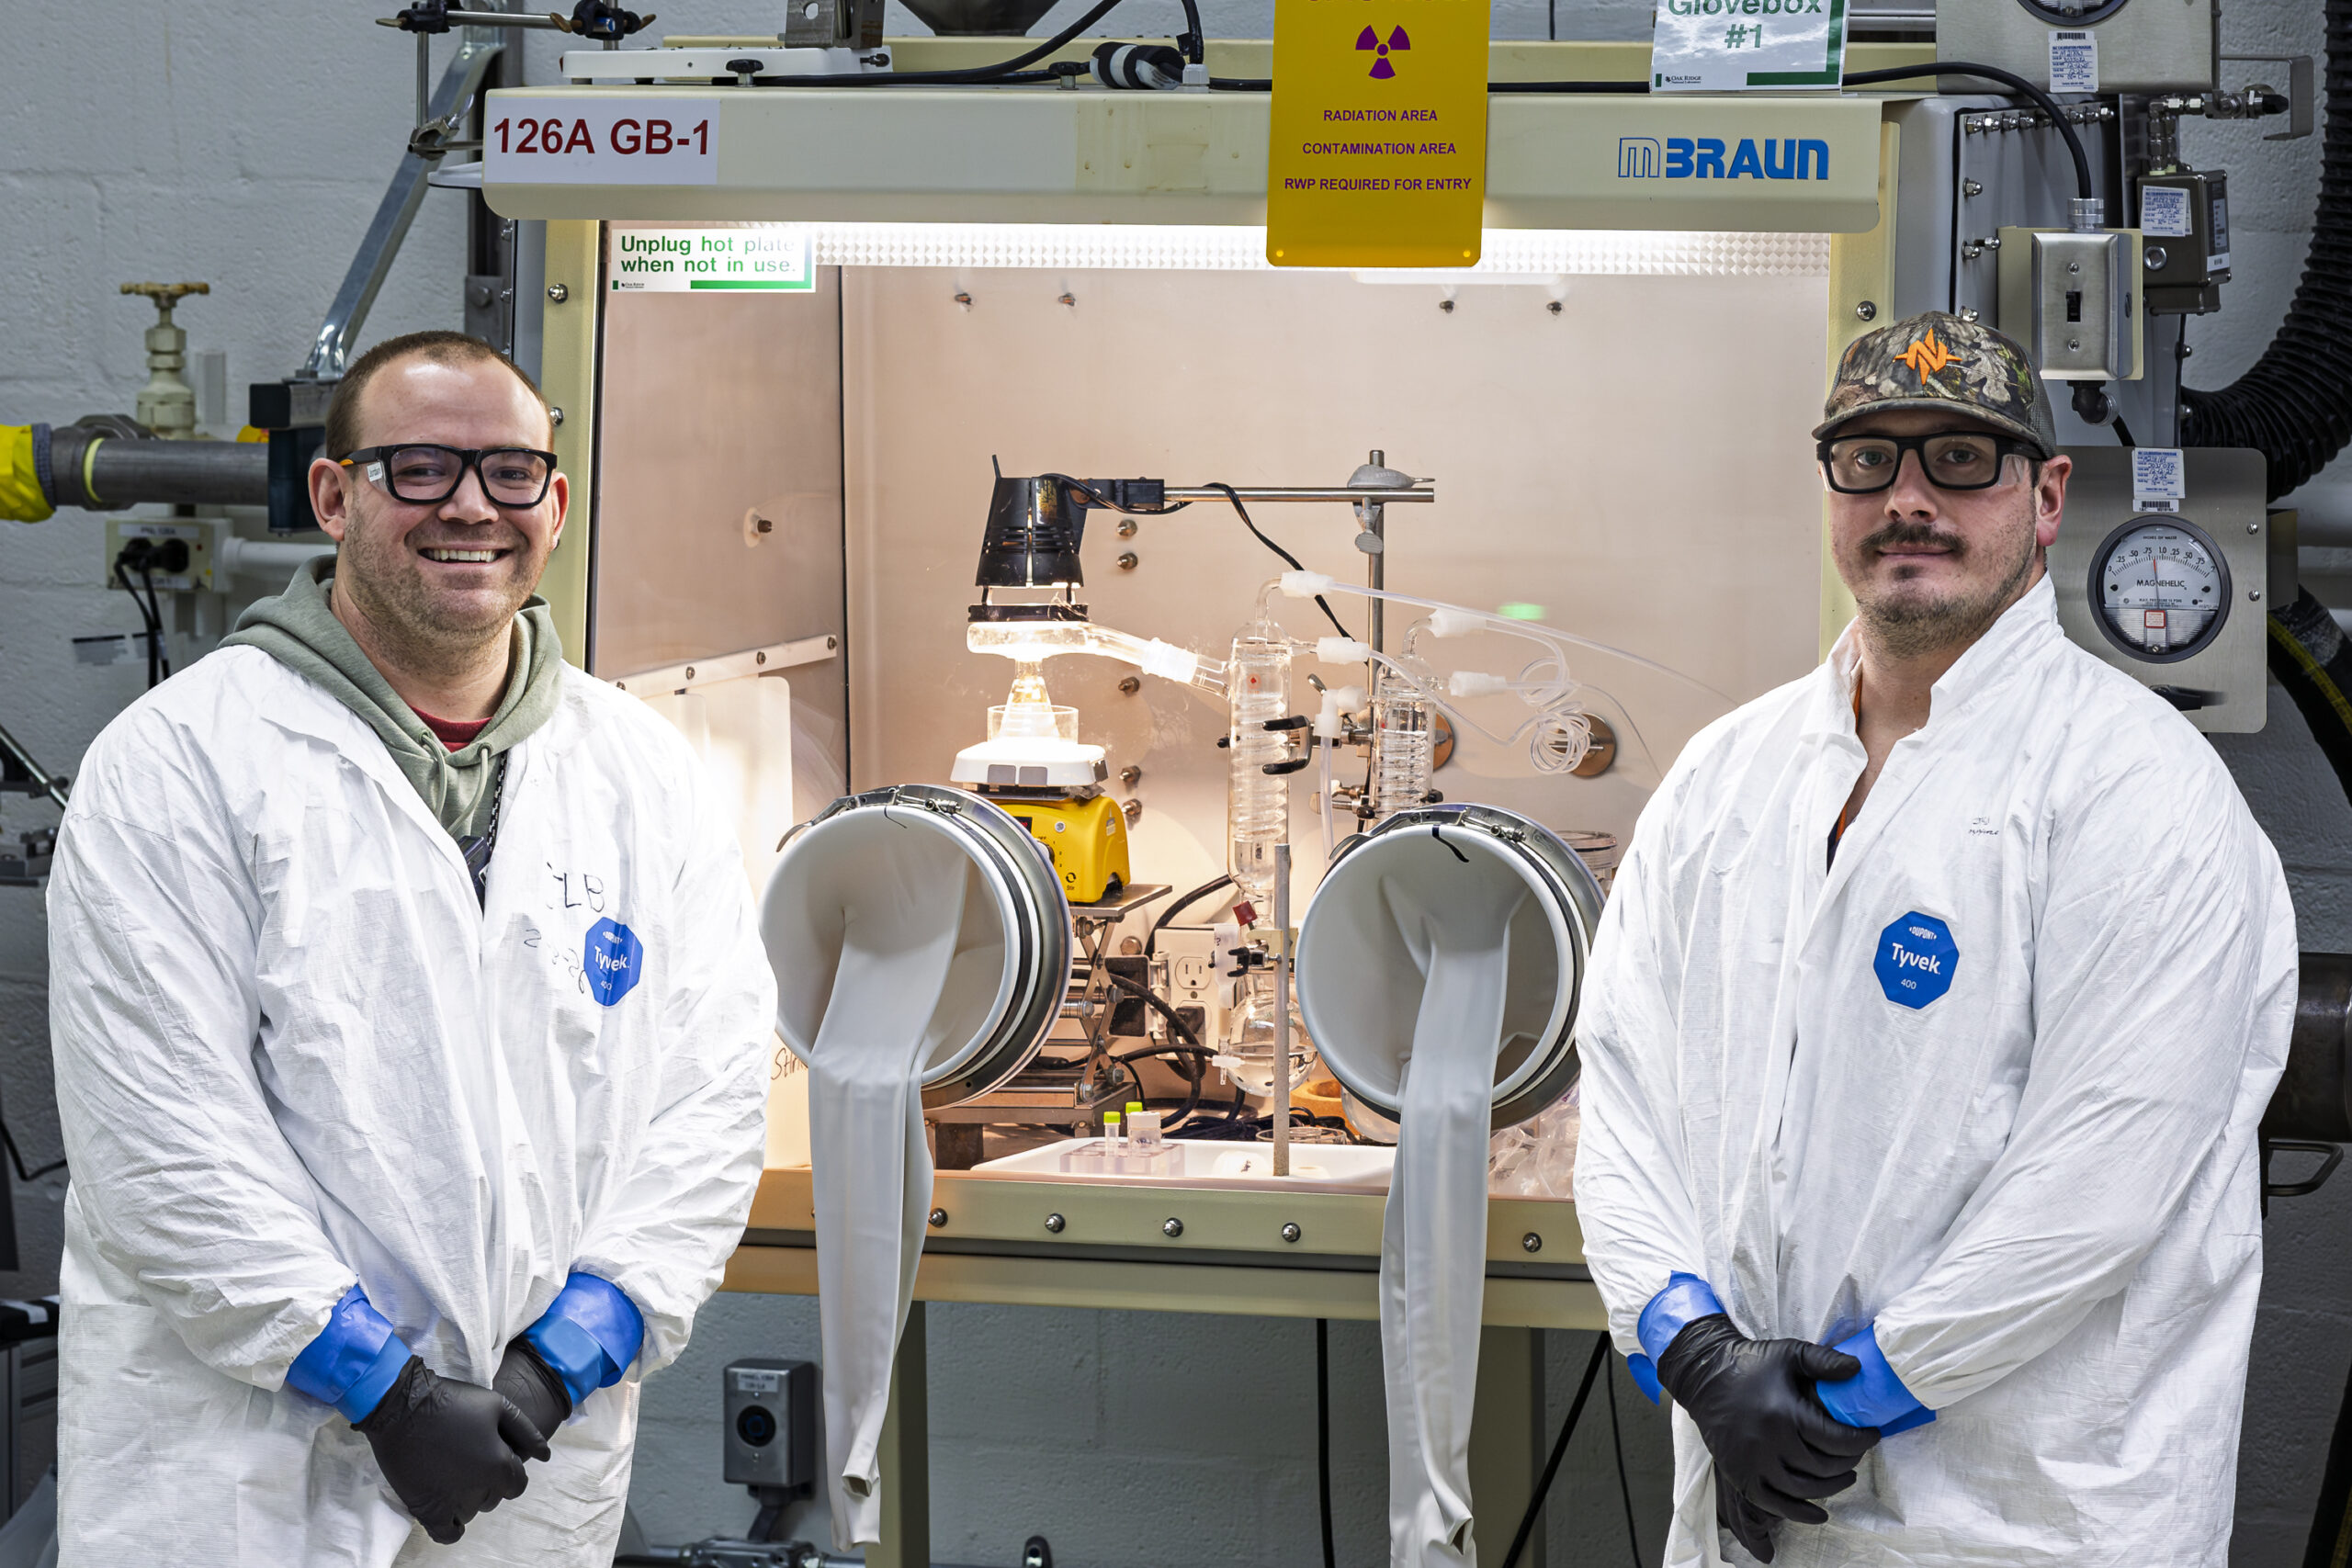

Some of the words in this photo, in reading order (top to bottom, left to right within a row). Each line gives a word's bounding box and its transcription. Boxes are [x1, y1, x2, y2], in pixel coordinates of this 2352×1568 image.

[1668, 0, 1822, 16] Glovebox
[1724, 23, 1762, 49] #1
[1323, 110, 1396, 121] RADIATION
[1400, 110, 1438, 121] AREA
[493, 118, 595, 154] 126A
[610, 118, 709, 156] GB-1
[1302, 142, 1415, 154] CONTAMINATION
[1419, 142, 1456, 154] AREA
[1284, 178, 1316, 190] RWP
[1319, 179, 1390, 191] REQUIRED
[1394, 179, 1422, 190] FOR
[1426, 178, 1472, 190] ENTRY
[621, 235, 691, 254] Unplug
[701, 235, 734, 253] hot
[744, 236, 795, 254] plate
[621, 258, 675, 274] when
[684, 258, 718, 274] not
[727, 257, 744, 274] in
[754, 260, 797, 273] use.
[594, 945, 628, 972] Tyvek
[1892, 942, 1941, 975] Tyvek
[1900, 978, 1917, 990] 400
